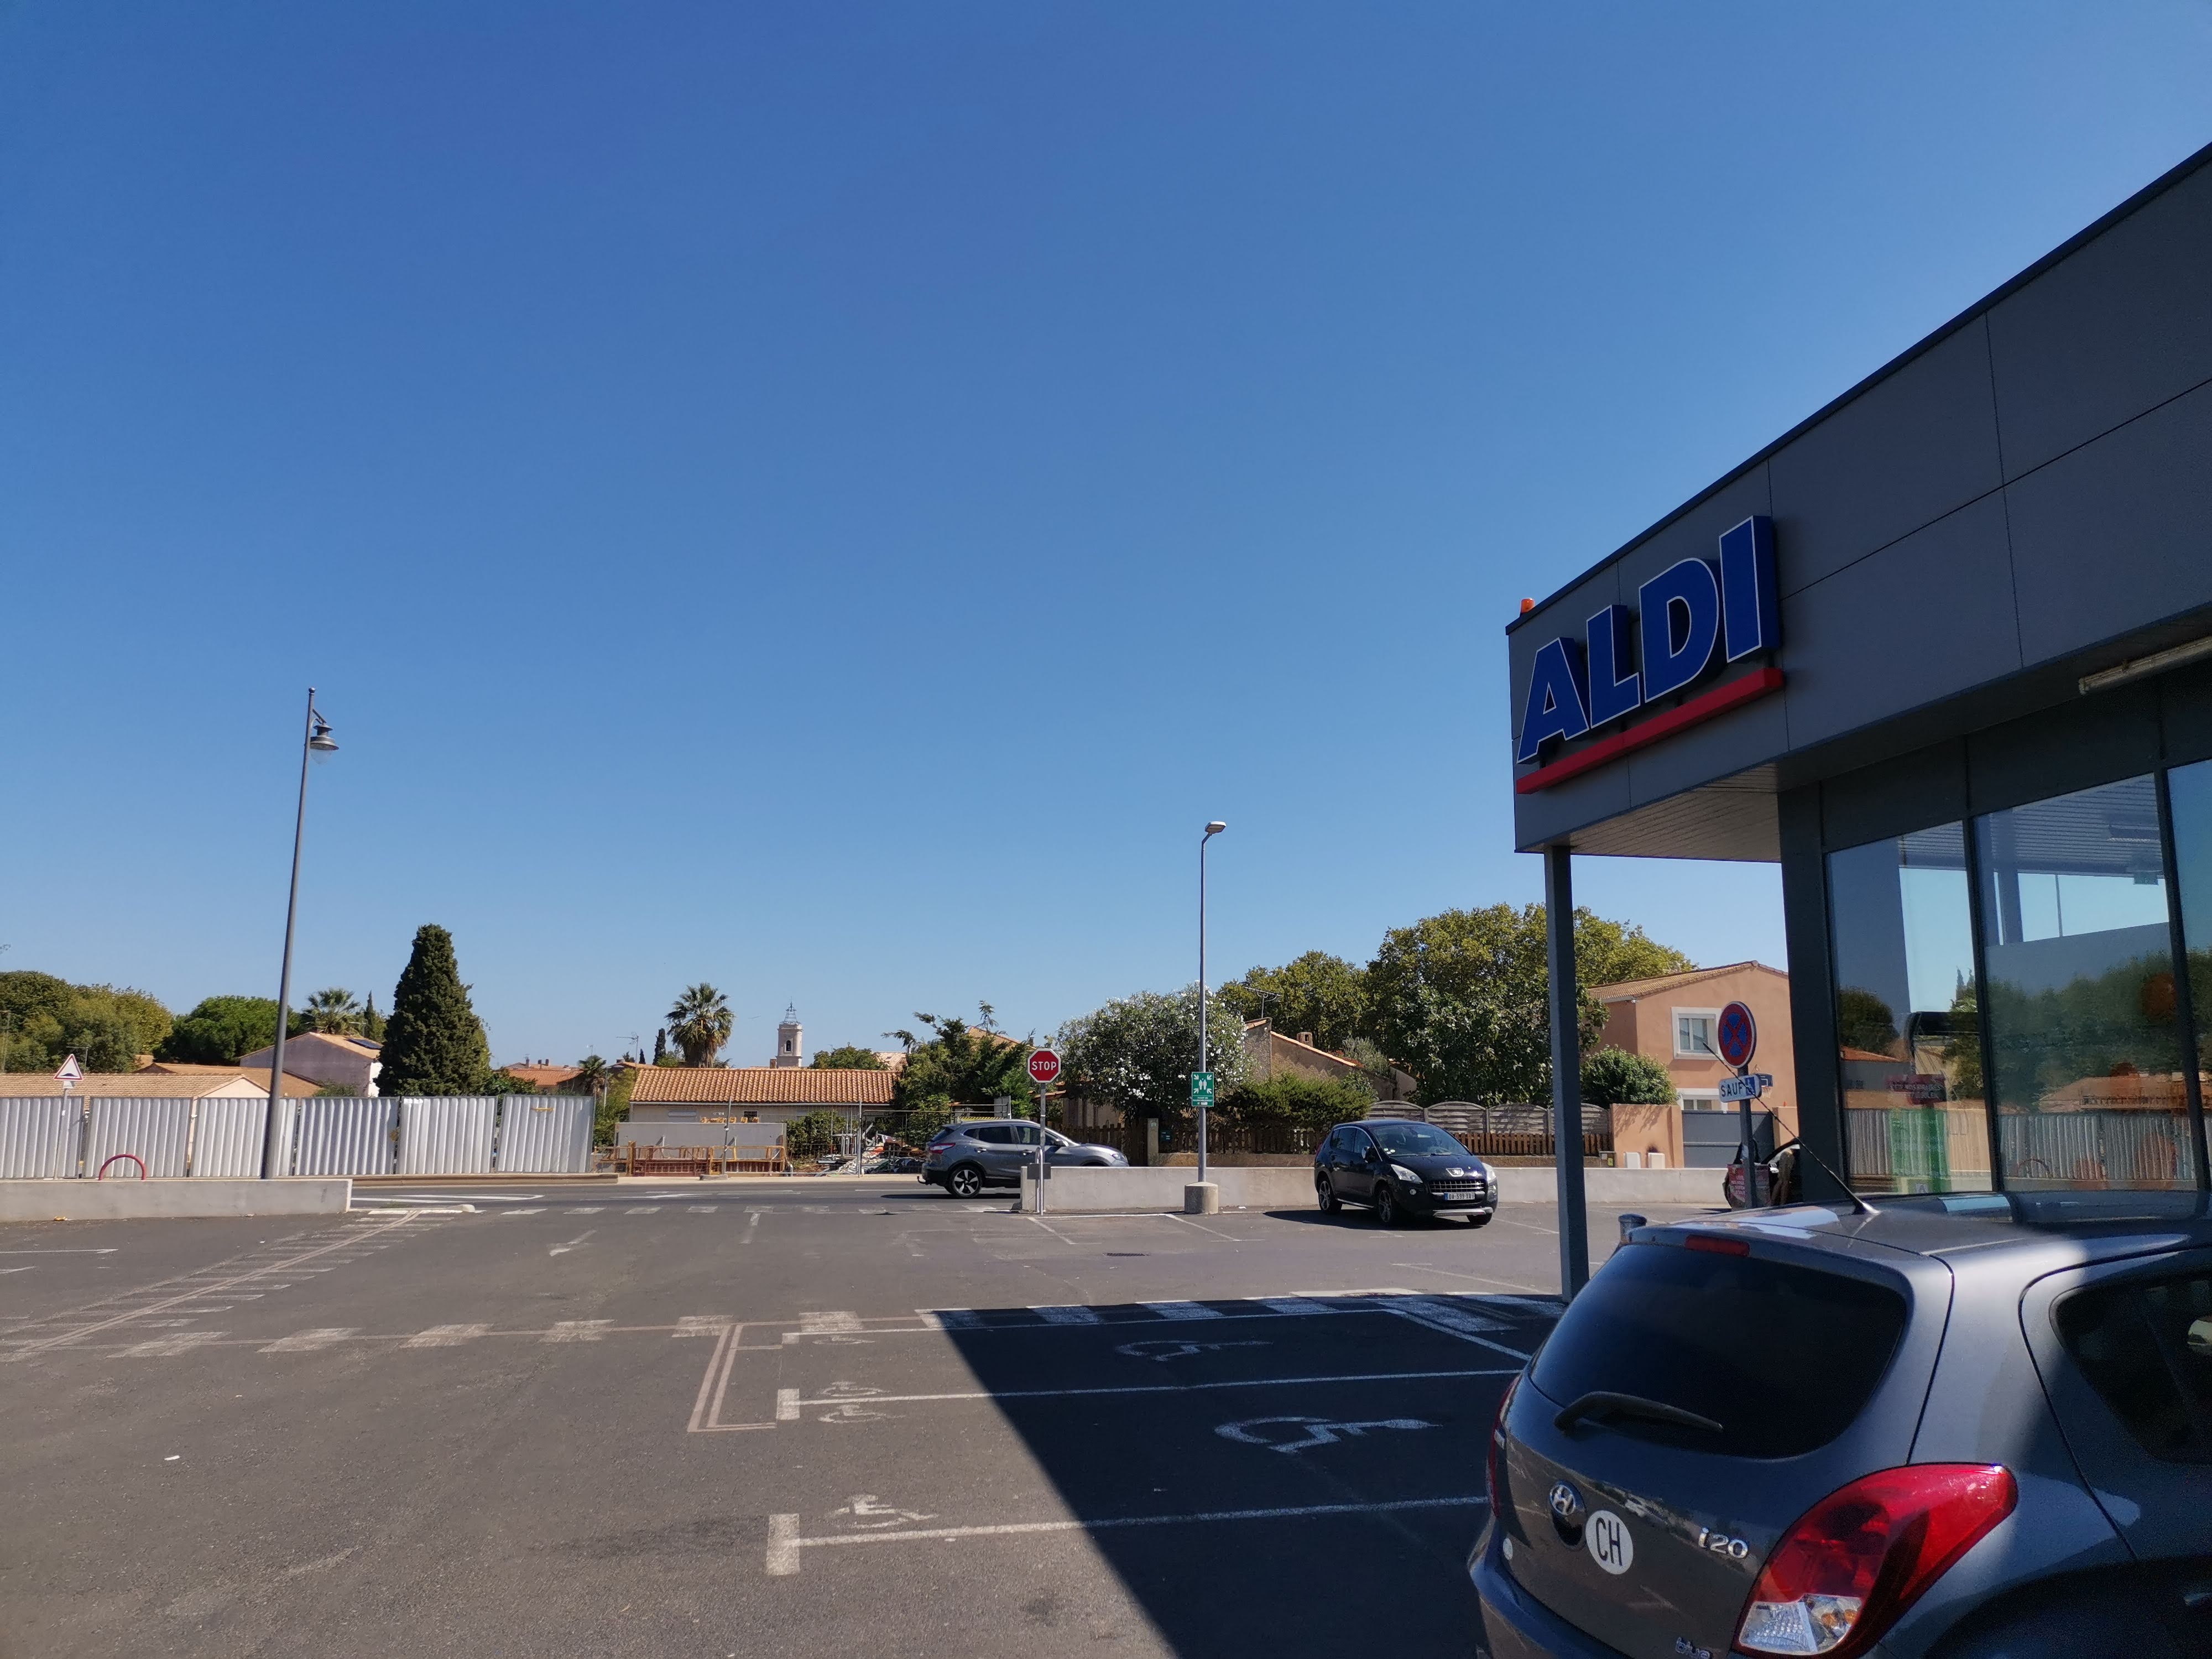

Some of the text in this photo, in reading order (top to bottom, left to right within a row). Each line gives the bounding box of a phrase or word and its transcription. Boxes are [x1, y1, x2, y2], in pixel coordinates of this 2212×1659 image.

[1516, 515, 1764, 764] ALDI
[1032, 1061, 1057, 1071] STOP
[1721, 1082, 1744, 1097] SAUF
[1596, 1517, 1622, 1566] CH
[1699, 1527, 1748, 1558] i20
